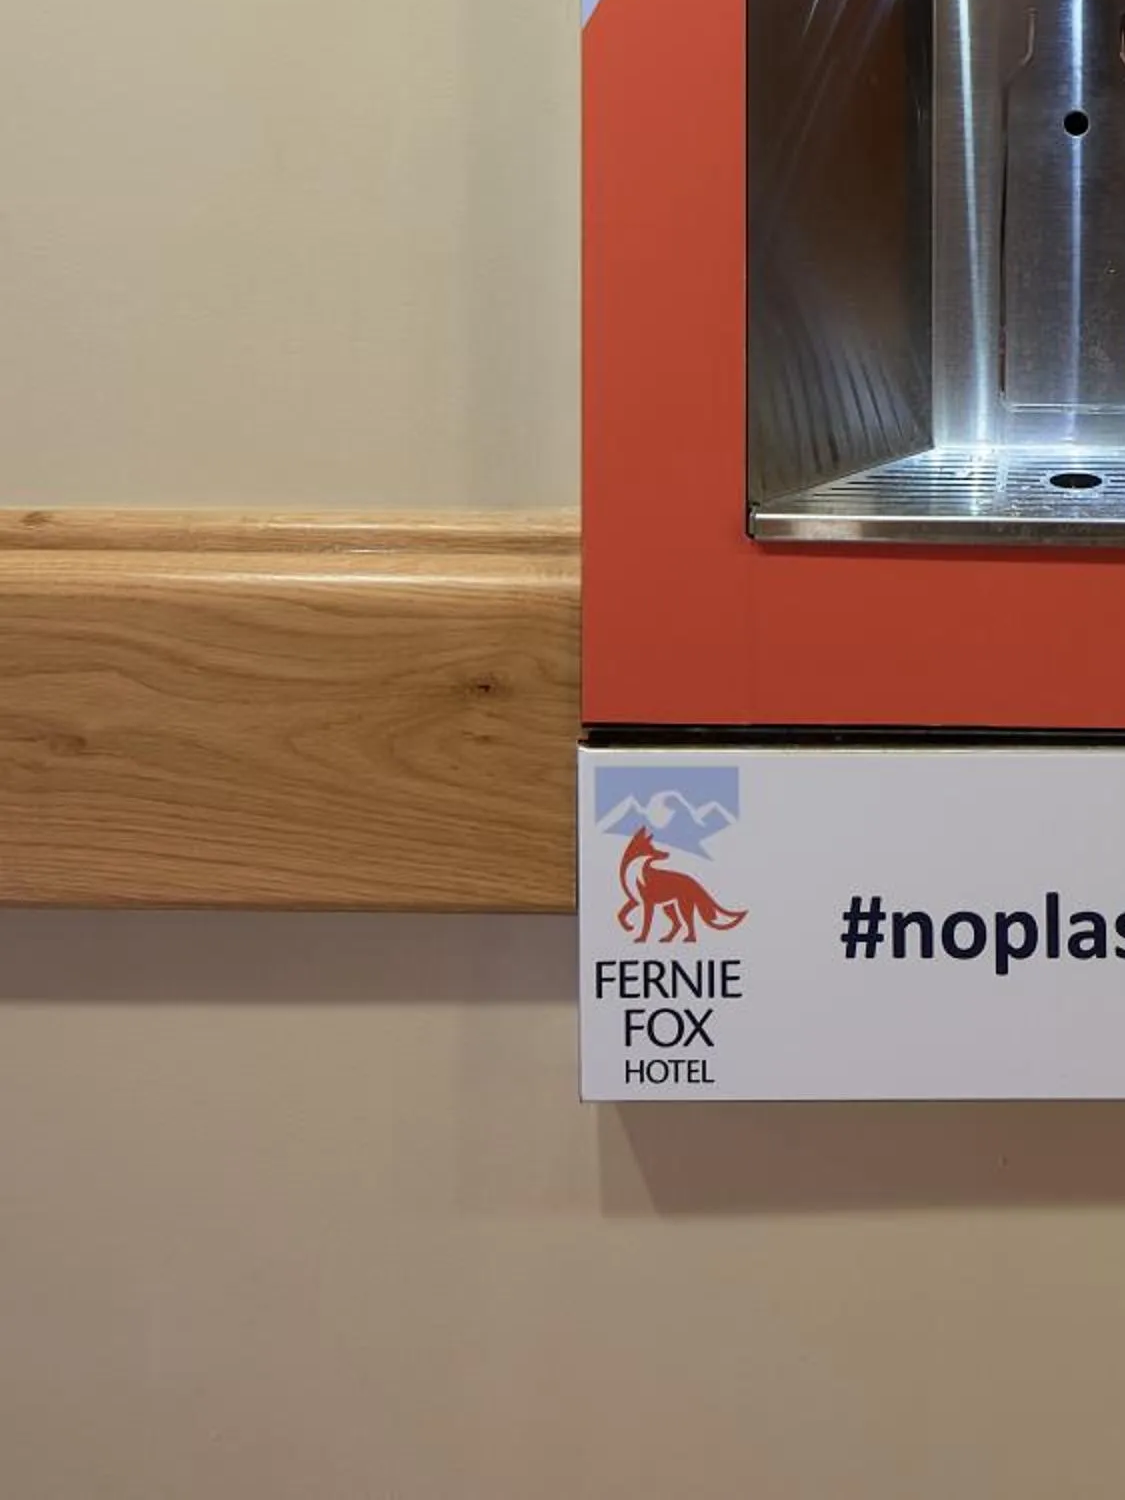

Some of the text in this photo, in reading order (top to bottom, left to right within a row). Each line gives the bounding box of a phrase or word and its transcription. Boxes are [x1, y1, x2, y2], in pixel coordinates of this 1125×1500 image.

[595, 959, 742, 999] FERNIE
[624, 1007, 715, 1048] FOX
[625, 1059, 715, 1085] HOTEL
